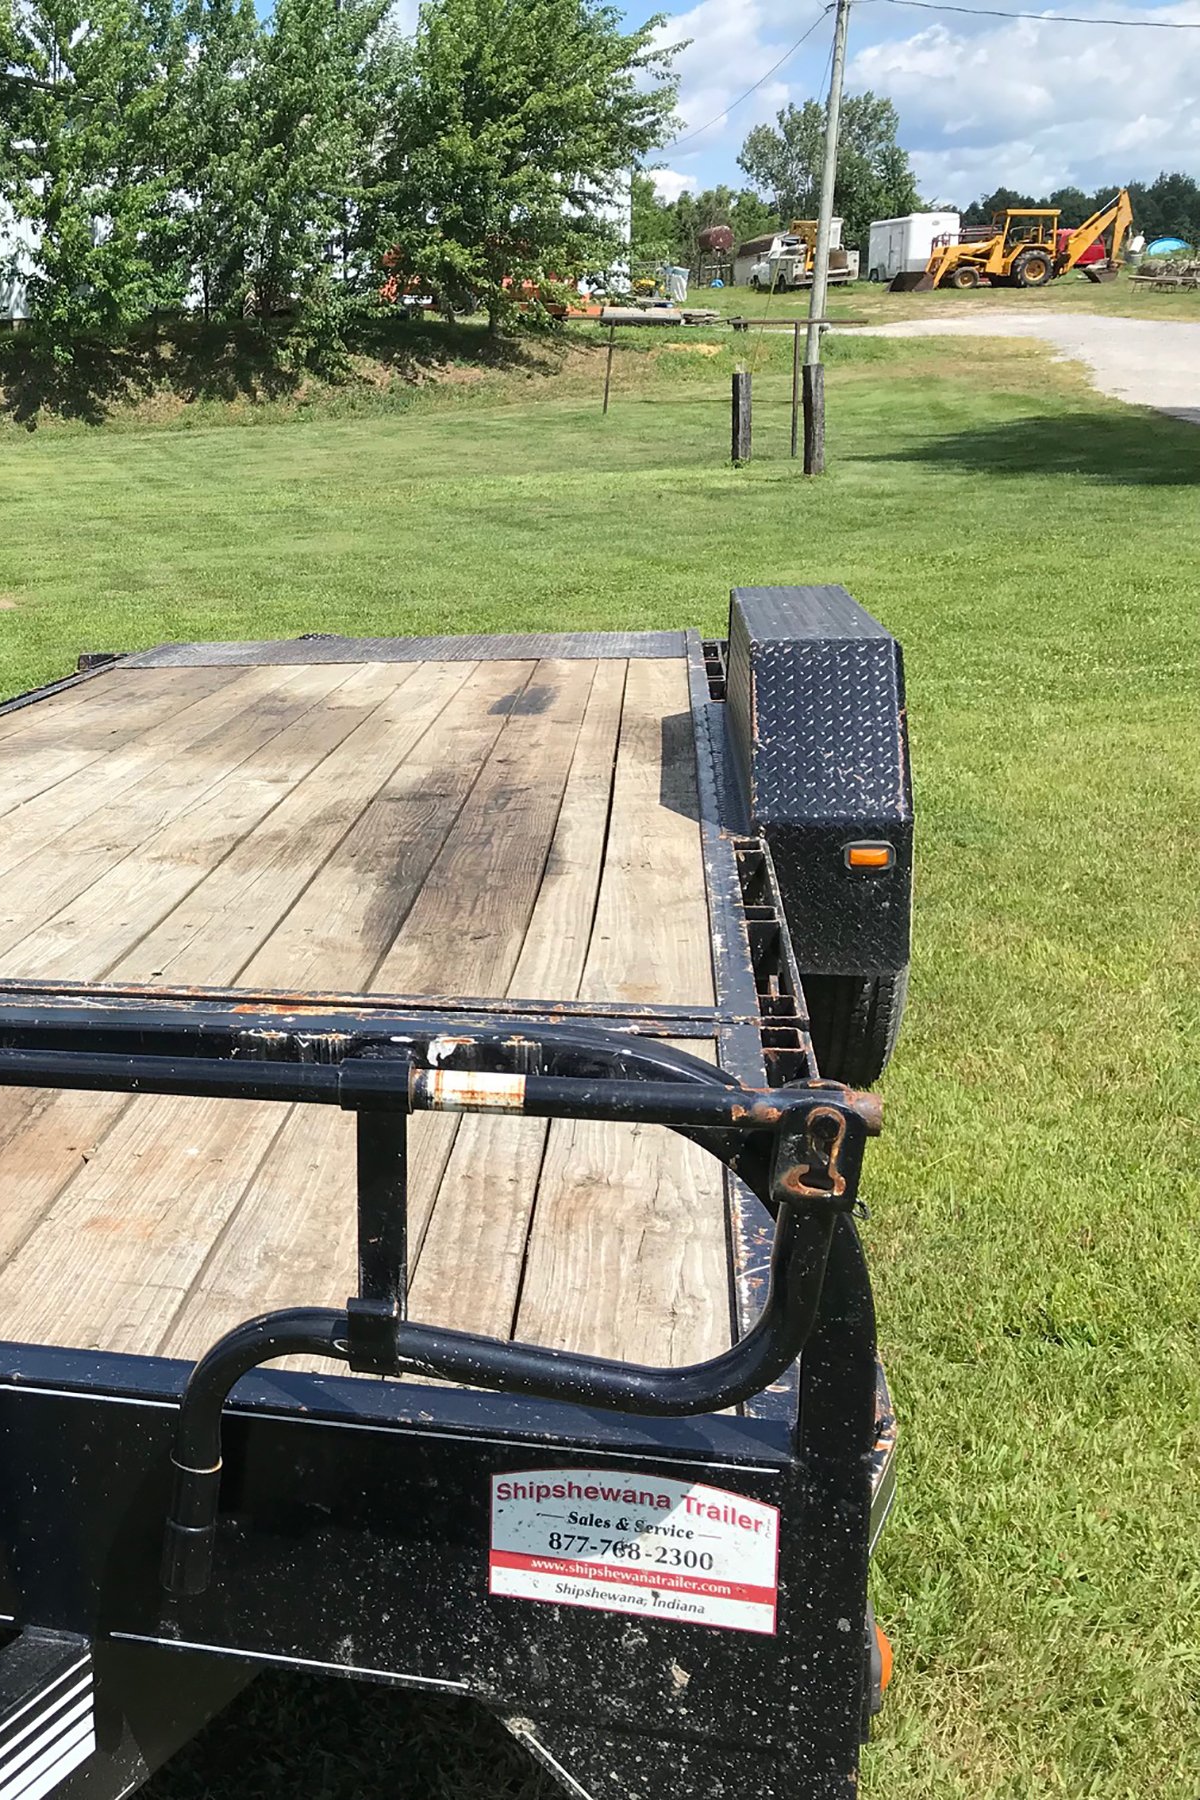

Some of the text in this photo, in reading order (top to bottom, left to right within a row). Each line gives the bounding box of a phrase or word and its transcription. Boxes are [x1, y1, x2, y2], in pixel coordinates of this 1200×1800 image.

[496, 1481, 764, 1533] Shipshewana Trailer
[567, 1511, 695, 1540] Sales & Service
[549, 1532, 714, 1571] 877-768-2300
[530, 1560, 732, 1595] www.shipshewanatrailer.com
[555, 1582, 705, 1614] Shipshewana, Indiana
